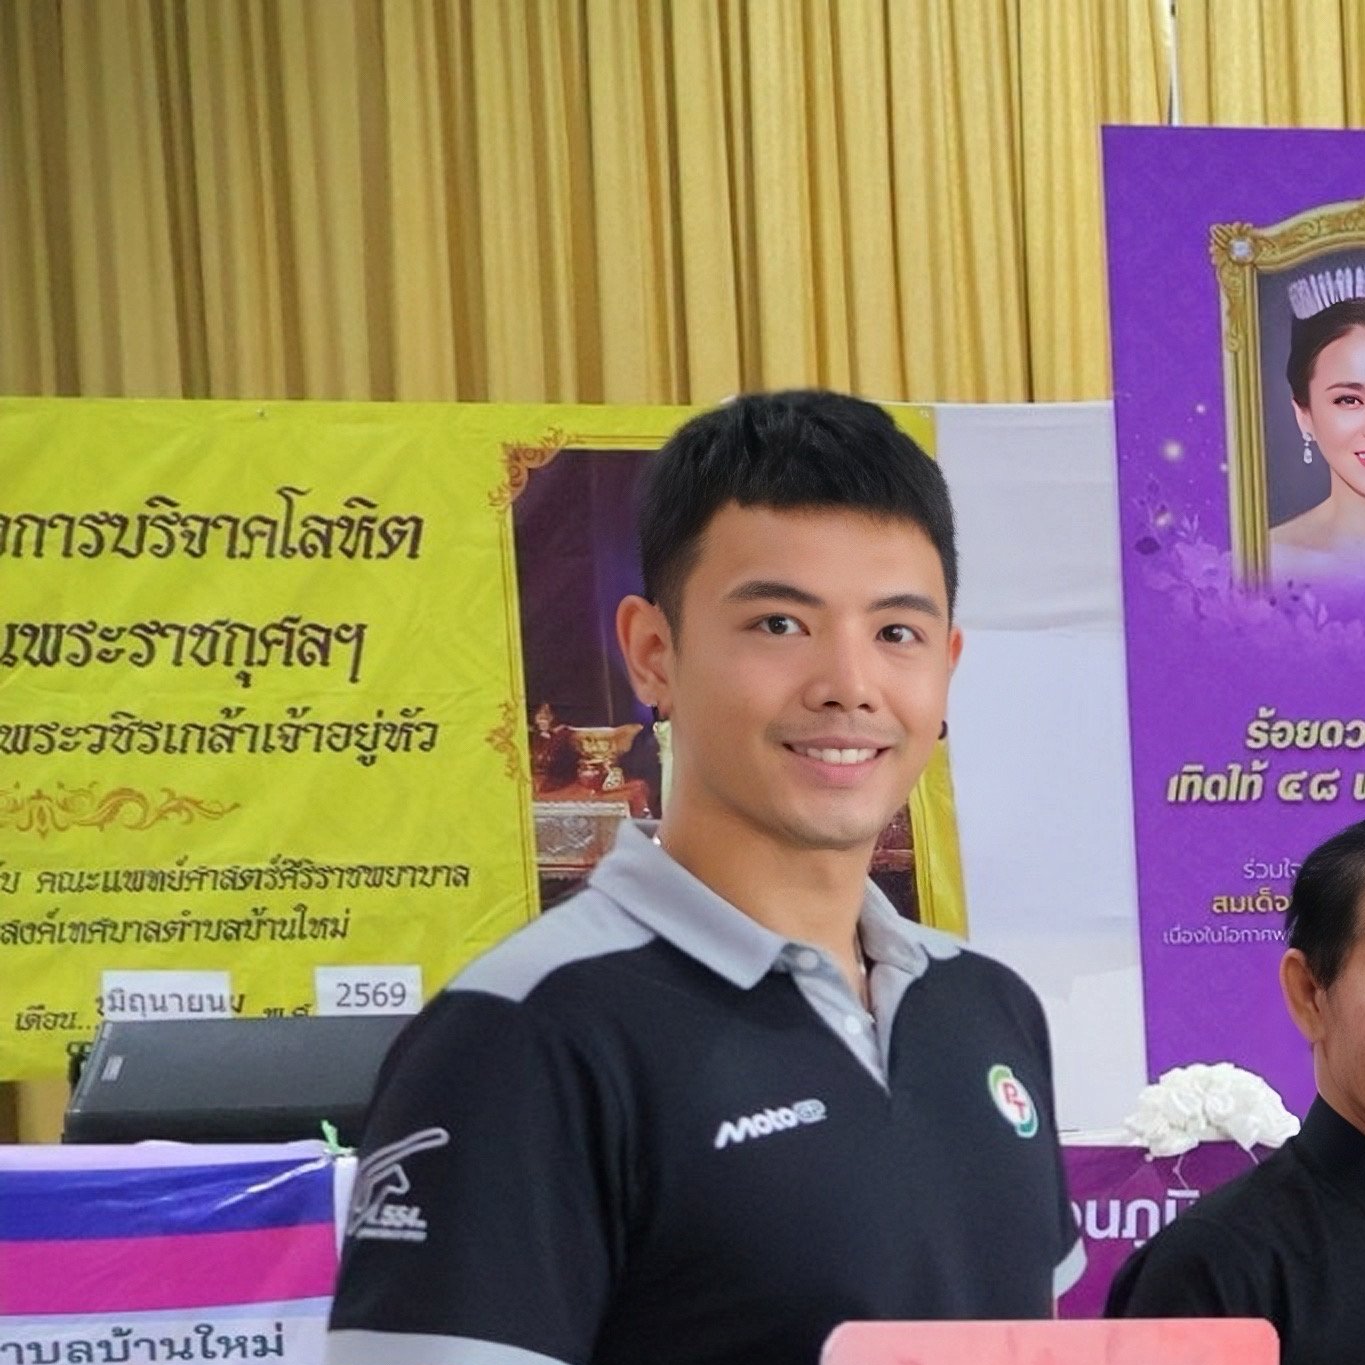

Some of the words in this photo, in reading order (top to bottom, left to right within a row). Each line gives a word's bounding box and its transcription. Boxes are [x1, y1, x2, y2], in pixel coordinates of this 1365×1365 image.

[0, 486, 425, 559] การบริจาคโลหิต
[1166, 758, 1269, 803] เทิดไท้
[335, 981, 408, 1009] 2569
